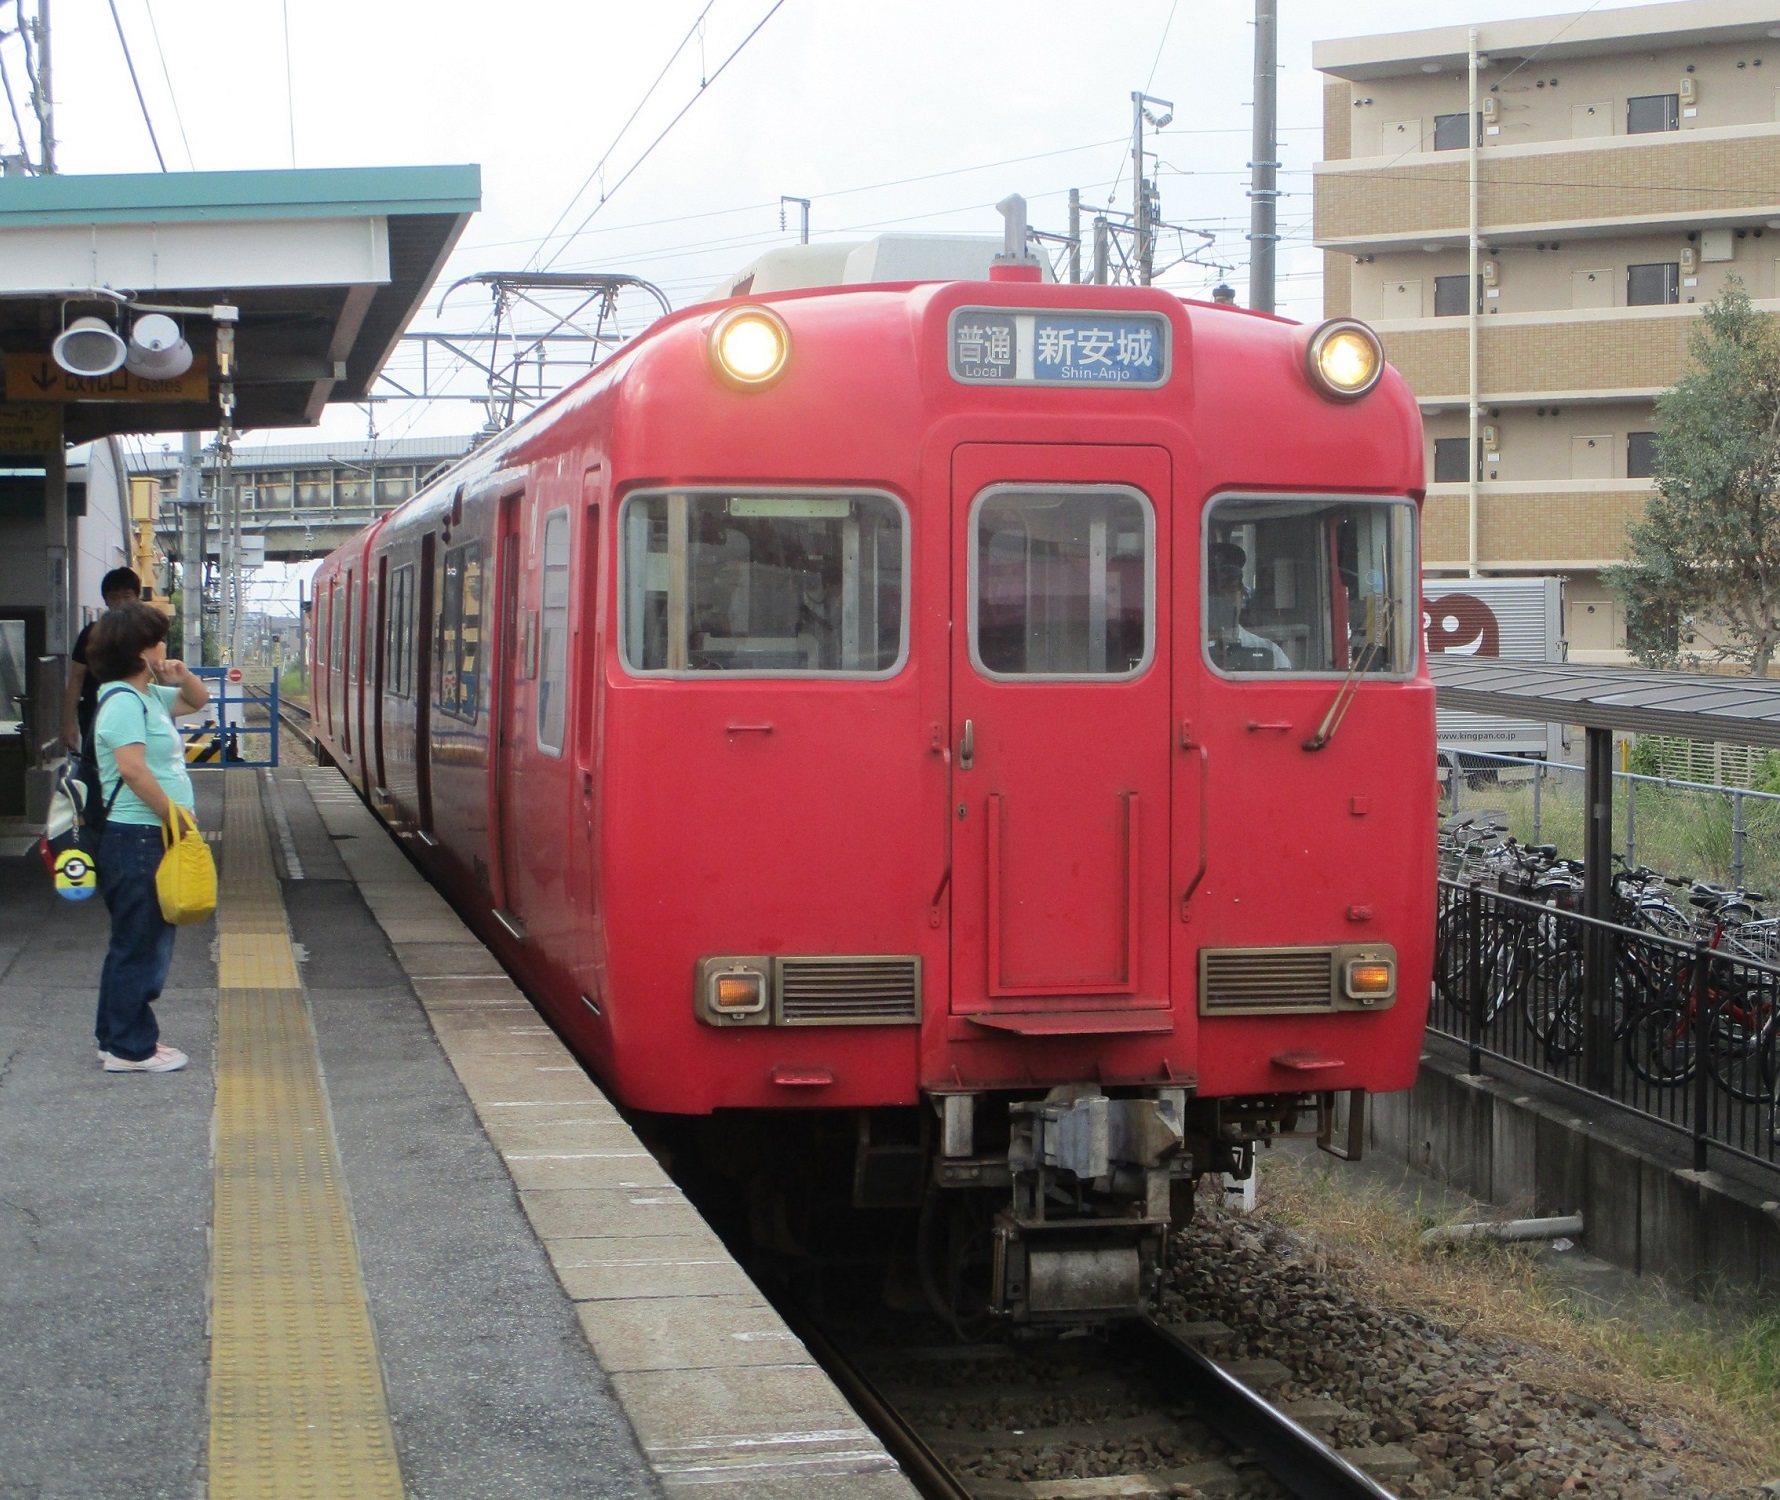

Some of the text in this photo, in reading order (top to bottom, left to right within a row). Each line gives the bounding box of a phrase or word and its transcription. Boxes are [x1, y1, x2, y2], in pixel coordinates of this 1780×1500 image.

[957, 325, 1011, 365] 普通
[1037, 326, 1154, 367] 新安城
[965, 365, 1002, 377] Local
[1061, 366, 1130, 382] Shin-Anjo
